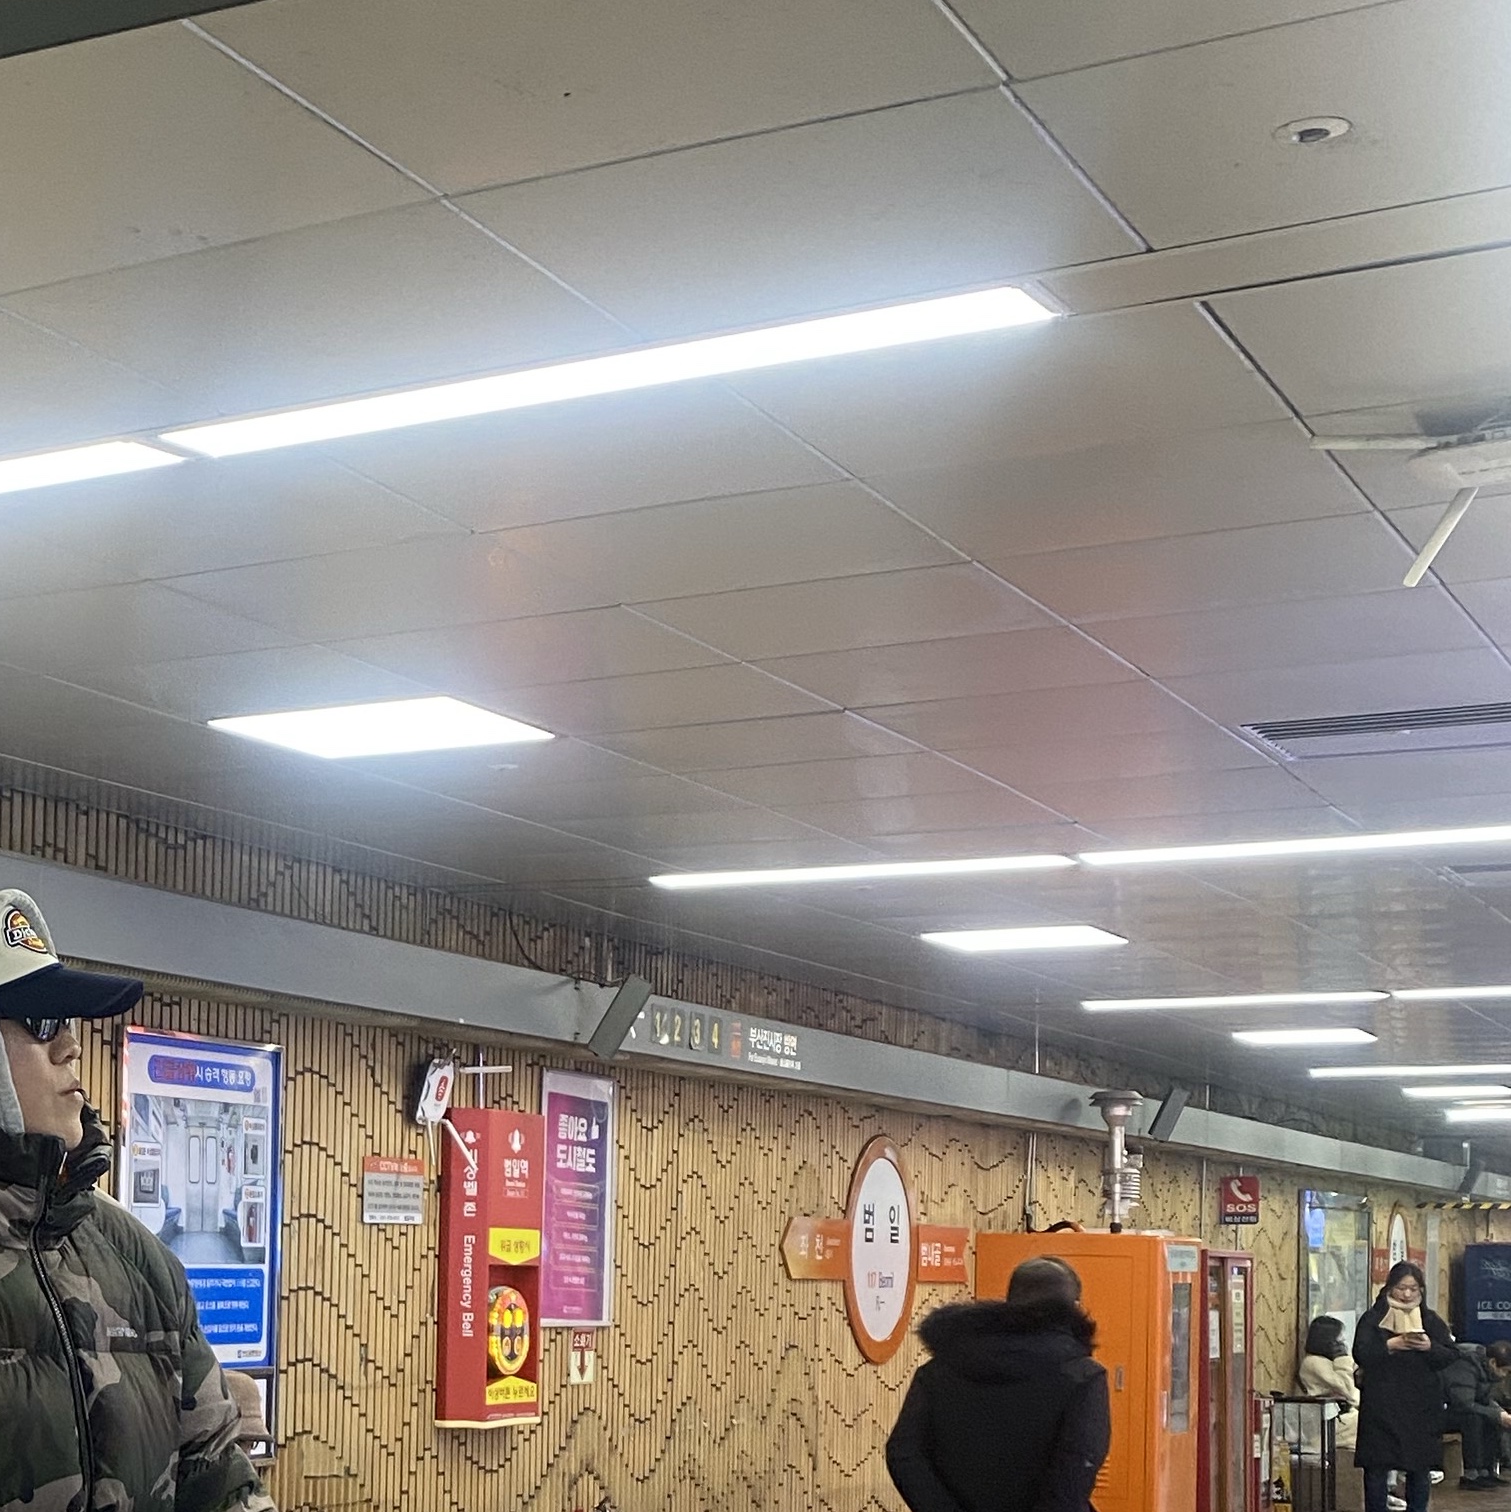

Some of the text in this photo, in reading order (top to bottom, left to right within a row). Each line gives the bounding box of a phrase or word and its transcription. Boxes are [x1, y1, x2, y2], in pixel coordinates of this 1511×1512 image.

[674, 1014, 681, 1042] 2
[693, 1018, 700, 1045] 3
[711, 1022, 719, 1049] 4
[504, 1158, 529, 1178] 범일역
[556, 1144, 595, 1173] 도시철도
[1226, 1203, 1257, 1213] SOS
[460, 1235, 476, 1337] Emergency Bell
